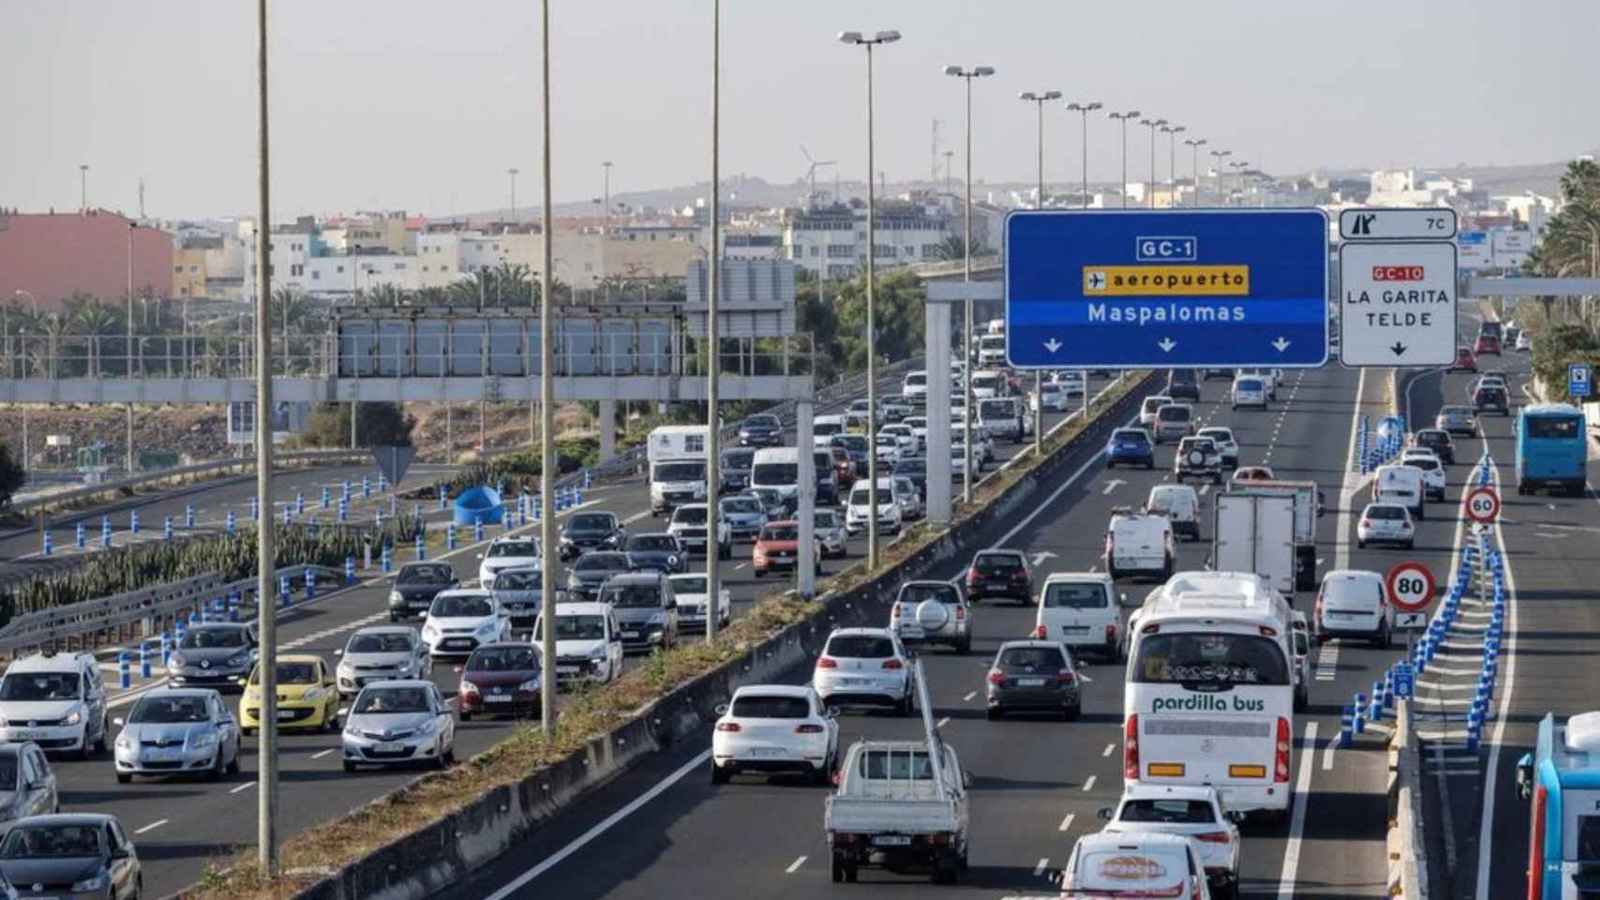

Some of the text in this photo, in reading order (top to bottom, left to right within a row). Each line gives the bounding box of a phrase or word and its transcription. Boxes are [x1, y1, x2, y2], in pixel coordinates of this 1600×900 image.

[1426, 218, 1445, 230] 7C
[1142, 241, 1192, 256] GC-1
[1113, 272, 1244, 289] aeropuerto
[1374, 268, 1422, 279] GC-10
[1347, 290, 1448, 304] LA GARITA
[1088, 303, 1245, 325] Maspalomas
[1366, 312, 1432, 327] TELDE
[1473, 499, 1492, 511] 60
[1398, 578, 1424, 595] 80
[1152, 694, 1265, 714] pardilla bus
